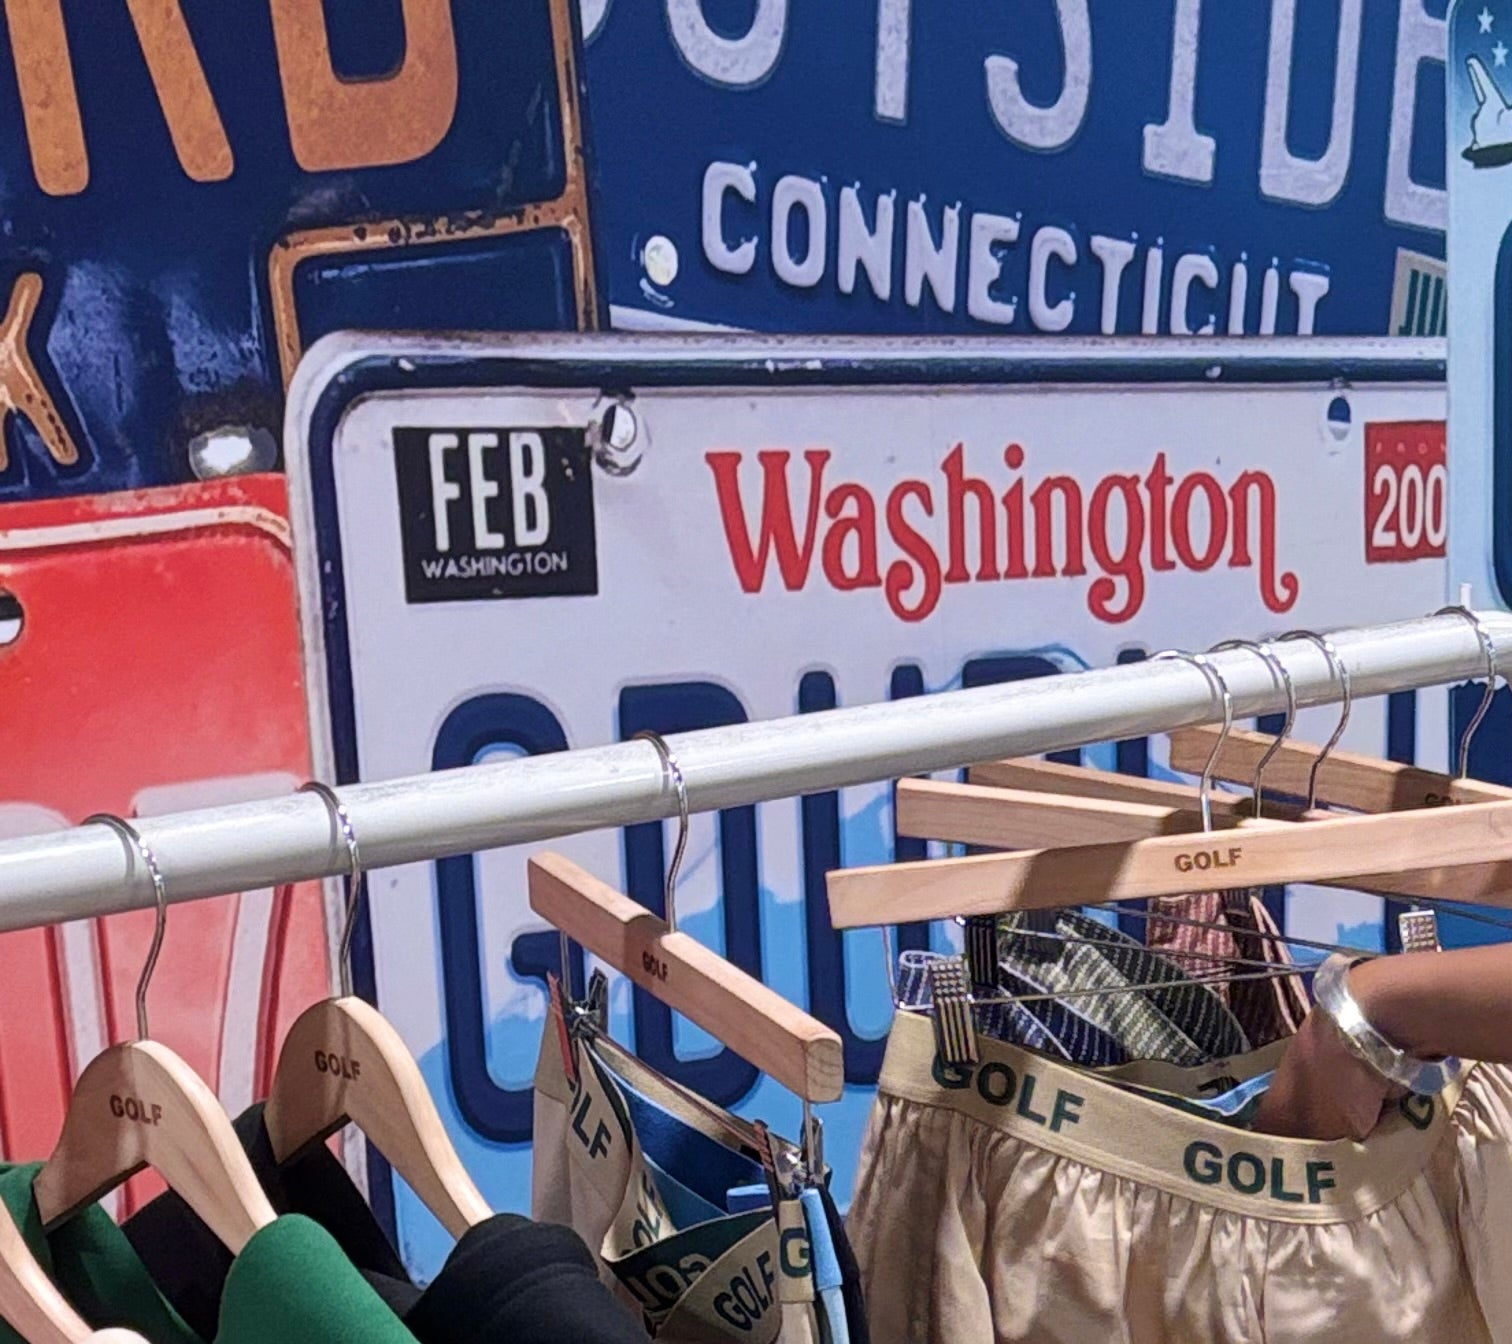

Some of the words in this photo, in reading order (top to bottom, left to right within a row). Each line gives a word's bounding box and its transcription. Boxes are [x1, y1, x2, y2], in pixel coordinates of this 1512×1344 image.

[701, 159, 1331, 337] CONNECTICUT
[428, 431, 550, 551] FEB
[421, 551, 569, 579] WASHINGTON
[704, 443, 1299, 624] Washington
[1173, 846, 1243, 874] GOLF
[641, 950, 669, 982] GOLF
[314, 1049, 361, 1081] GOLF
[930, 1054, 1085, 1134] GOLF
[110, 1094, 162, 1127] GOLF
[1183, 1139, 1336, 1204] GOLF
[713, 1250, 776, 1332] GOLF
